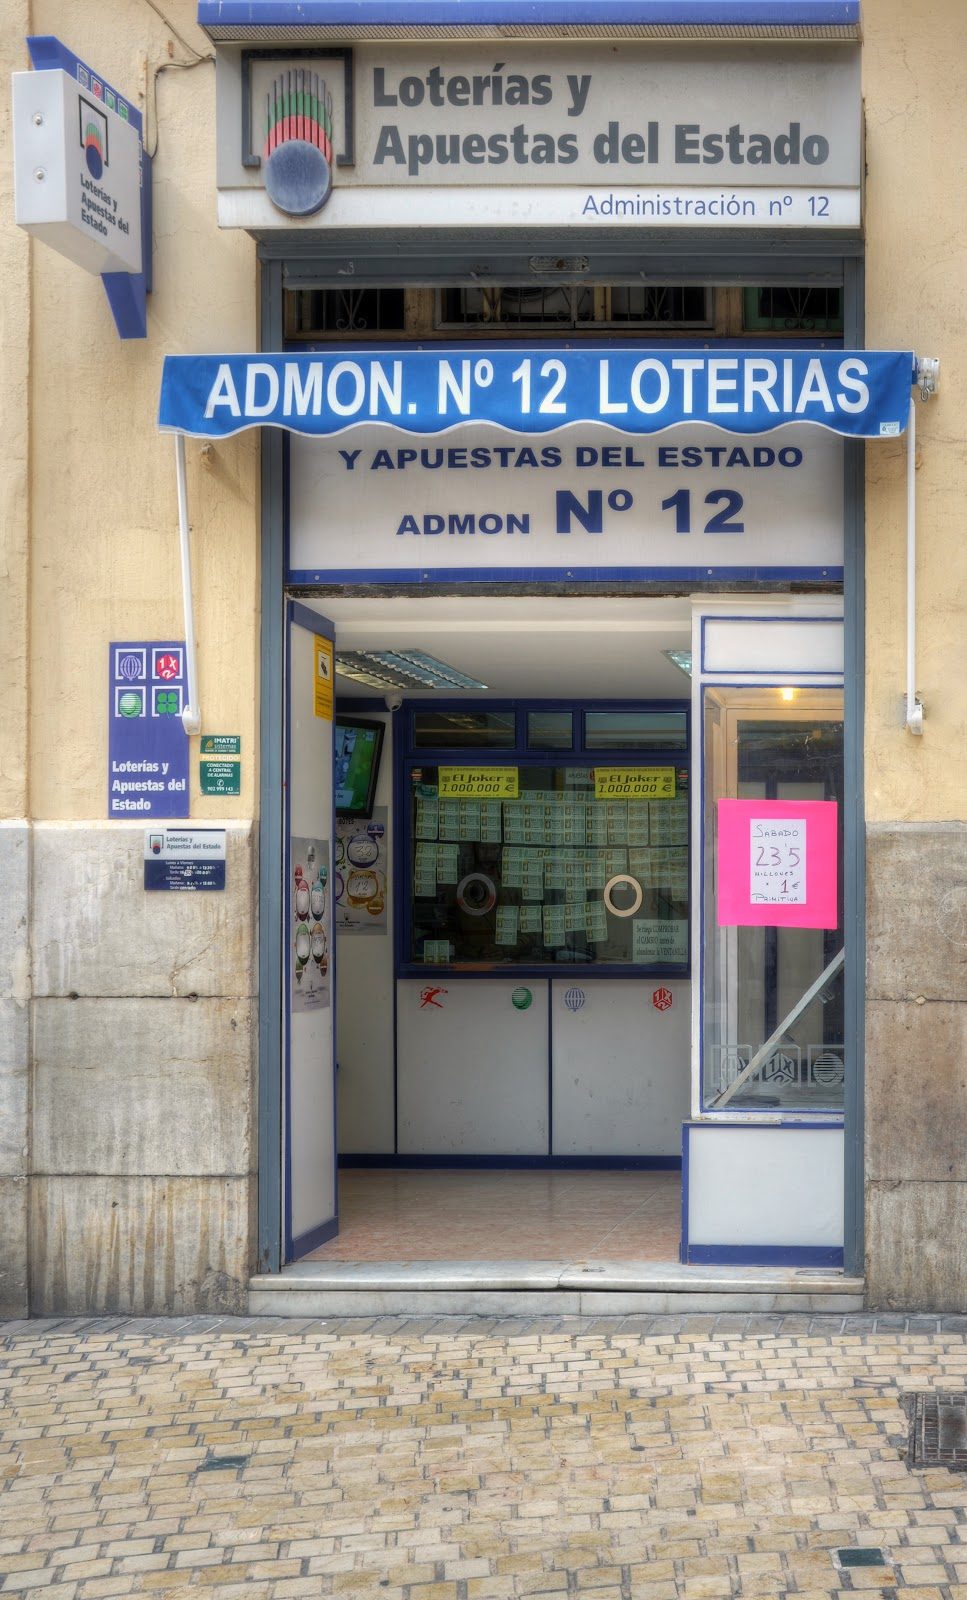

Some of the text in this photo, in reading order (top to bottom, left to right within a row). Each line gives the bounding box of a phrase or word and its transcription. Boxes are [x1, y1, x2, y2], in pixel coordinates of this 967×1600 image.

[373, 63, 592, 117] Loterías y
[373, 118, 830, 176] Apuestas del Estado
[80, 173, 118, 212] Loterías y
[582, 193, 830, 217] Administración nº 12
[81, 207, 108, 236] Estado
[82, 192, 129, 235] Apuestas del
[204, 358, 870, 419] ADMON. Nº 12 LOTERIAS
[337, 446, 803, 470] Y APUESTAS DEL ESTADO
[396, 488, 745, 536] ADMON Nº 12
[112, 760, 169, 776] Loterías y
[112, 779, 186, 794] Apuestas del
[442, 783, 500, 793] 1.000.000
[599, 784, 657, 793] 1.000.000
[112, 798, 152, 811] Estado
